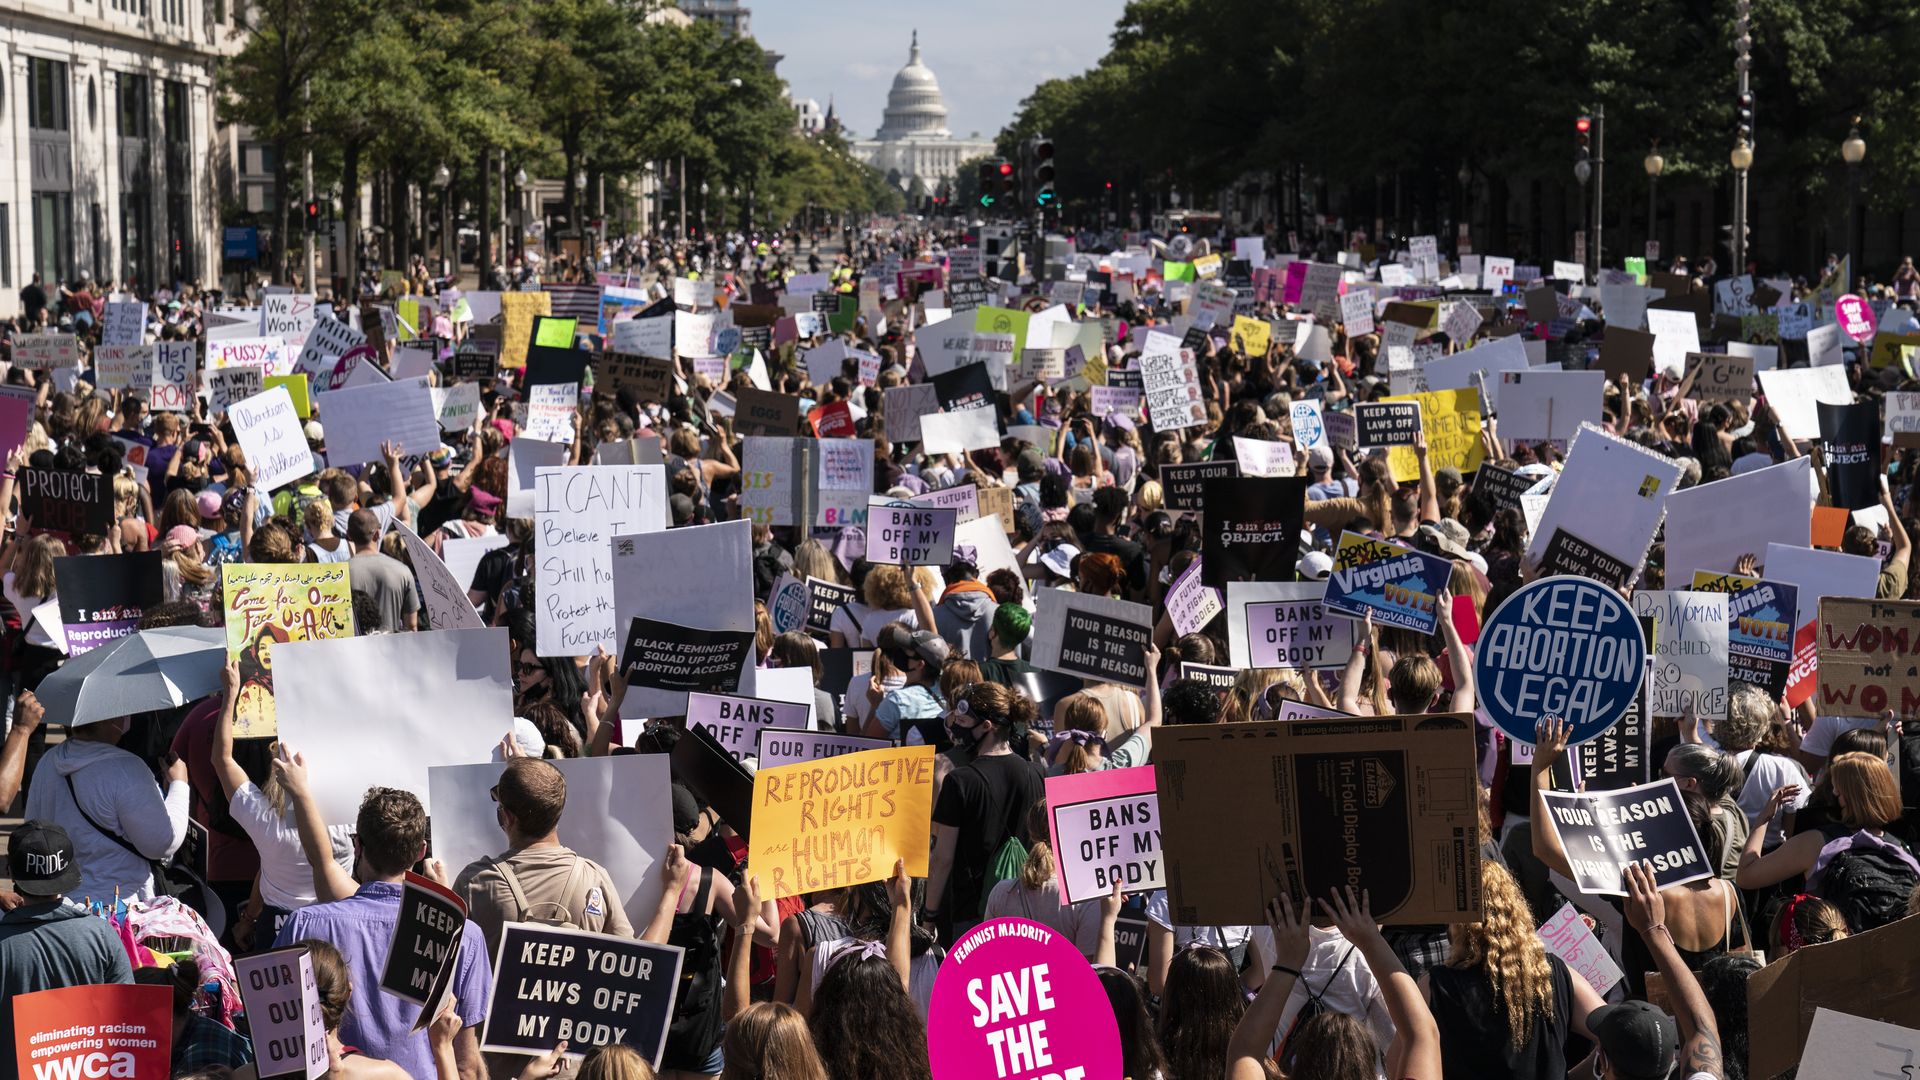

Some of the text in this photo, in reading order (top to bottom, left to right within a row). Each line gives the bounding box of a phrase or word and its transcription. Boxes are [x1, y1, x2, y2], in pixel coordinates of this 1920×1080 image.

[266, 298, 287, 314] We
[1841, 302, 1862, 315] SAVE
[267, 317, 302, 333] Won't
[1846, 322, 1871, 334] COURT
[1847, 313, 1862, 323] THE
[319, 318, 363, 346] Mind
[158, 344, 192, 364] Her
[222, 345, 268, 361] PUSSY
[162, 365, 185, 383] US
[230, 372, 259, 385] WITH
[152, 384, 194, 407] ROAR
[227, 388, 249, 399] HER
[1416, 394, 1440, 415] NO
[1152, 407, 1185, 419] CONTROL
[1154, 415, 1188, 428] WOMEN
[1363, 406, 1413, 417] KEEP YOUR
[1367, 419, 1413, 430] LAWS OFF
[264, 430, 284, 448] is
[1370, 432, 1411, 442] MY BODY
[1170, 467, 1228, 479] KEEP YOUR
[1485, 469, 1530, 490] KEEP YOUR
[535, 473, 562, 514] I
[937, 490, 972, 505] FUTURE
[1173, 484, 1203, 494] LAWS
[1484, 482, 1507, 496] LAWS
[1178, 498, 1193, 507] MY
[892, 512, 933, 526] BANS
[1222, 521, 1282, 532] I am an
[543, 519, 600, 547] Believe
[882, 528, 912, 543] OFF
[919, 531, 940, 544] MY
[890, 547, 930, 561] BODY
[1337, 546, 1392, 568] TEXAS
[1560, 537, 1622, 577] KEEP YOUR
[542, 557, 585, 586] Still
[1332, 554, 1425, 594] Virginia
[1555, 554, 1585, 577] LAWS
[231, 586, 296, 611] Come for
[814, 585, 840, 599] KEEP
[1187, 588, 1208, 613] FIGHT
[1384, 583, 1436, 613] VOTE
[78, 606, 143, 622] I am an
[547, 594, 591, 624] Protest
[814, 614, 828, 625] MY
[1190, 600, 1216, 629] BODIES
[1275, 605, 1322, 623] BANS
[1521, 584, 1621, 633] KEEP
[1669, 594, 1722, 641] WOMAN
[1871, 603, 1895, 619] I'm
[241, 605, 336, 644] Face All
[1070, 616, 1148, 645] YOUR REASON
[1266, 625, 1333, 643] OFF MY
[1738, 617, 1789, 641] VOTE
[634, 638, 740, 654] BLACK FEMINISTS
[1088, 637, 1125, 656] IS THE
[1278, 646, 1326, 663] BODY
[1486, 623, 1636, 683] ABORTION
[1668, 641, 1711, 656] CHILD
[629, 661, 738, 675] ABORTION ACCESS
[643, 651, 731, 664] SQUAD UP FOR
[1063, 650, 1145, 679] RIGHT REASON
[1730, 656, 1772, 671] am an
[1190, 671, 1235, 687] KEEP YOUR
[1864, 663, 1918, 677] not a
[1493, 670, 1616, 725] LEGAL
[719, 701, 775, 725] BANS
[706, 723, 744, 745] OFF
[769, 740, 804, 757] OUR
[1604, 726, 1617, 772] LAWS
[1625, 744, 1639, 767] MY
[764, 757, 935, 806] REPRODUCTIVE
[1365, 759, 1379, 806] ELMER'S
[800, 789, 896, 833] RIGHTS
[1089, 802, 1151, 831] BANS
[1340, 760, 1361, 863] Tri-Fold Display
[1553, 796, 1674, 826] YOUR REASON
[763, 843, 790, 856] are
[1080, 835, 1120, 862] OFF
[1588, 831, 1647, 852] IS THE
[26, 850, 65, 875] PRIDE
[1573, 858, 1614, 879] RIGHT
[772, 857, 872, 899] RIGHTS
[1095, 860, 1157, 889] BODY
[416, 902, 453, 935] KEEP
[953, 923, 1052, 965] FEMINIST MAJORITY
[521, 941, 653, 980] KEEP YOUR
[249, 964, 294, 991] OUR
[411, 968, 436, 991] MY
[517, 978, 642, 1014] LAWS OFF
[966, 963, 1056, 1028] SAVE
[30, 1023, 146, 1045] eliminating racism
[517, 1014, 627, 1046] MY BODY
[31, 1036, 157, 1059] empowering women
[986, 1019, 1053, 1079] THE
[32, 1051, 136, 1080] ywca
